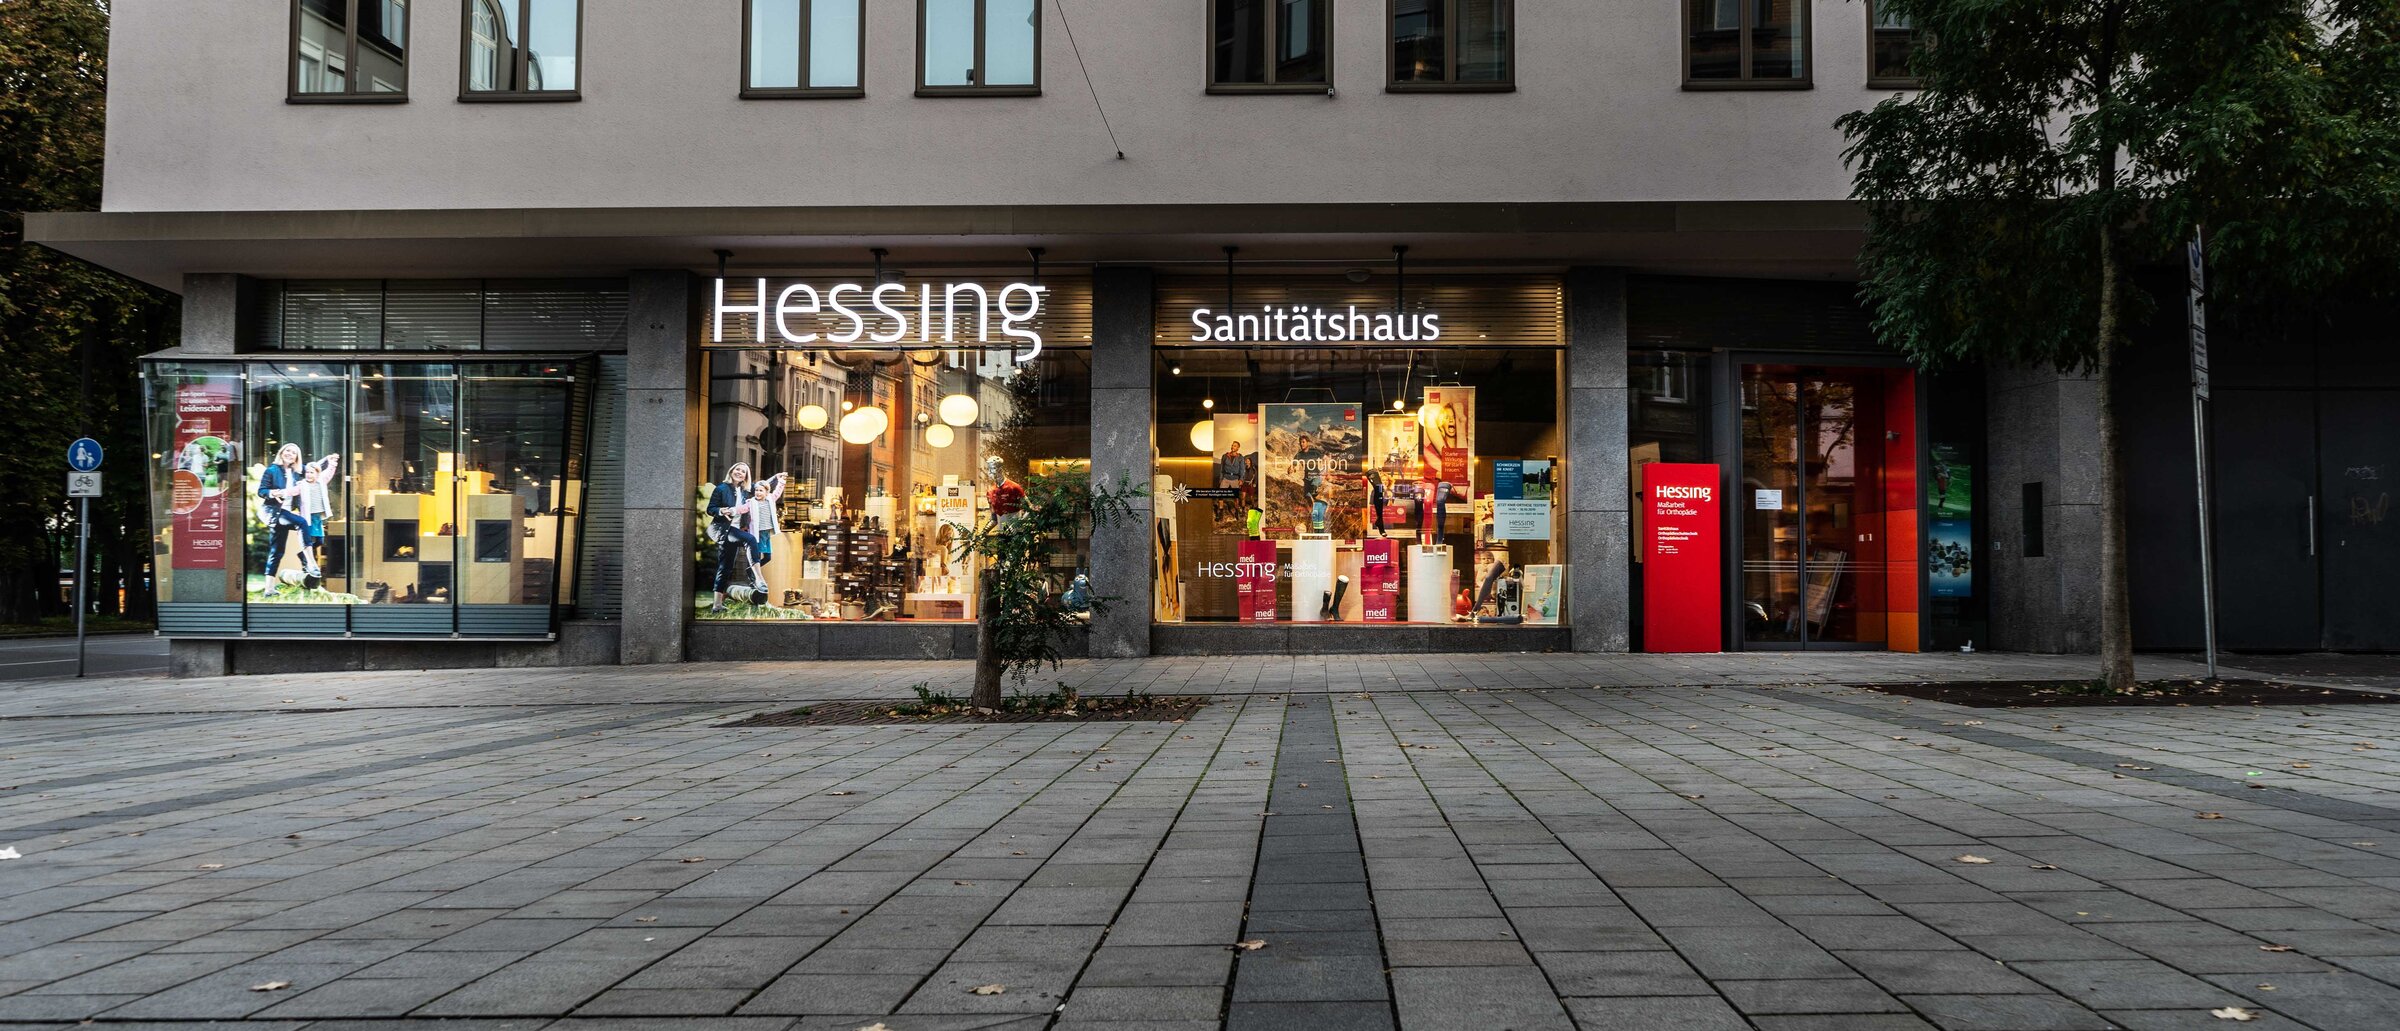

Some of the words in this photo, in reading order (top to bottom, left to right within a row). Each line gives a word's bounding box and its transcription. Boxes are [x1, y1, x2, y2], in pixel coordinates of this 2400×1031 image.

[713, 278, 1046, 362] Hessing
[1191, 305, 1440, 341] Sanitätshaus
[180, 404, 227, 412] Leidenschaft
[1656, 485, 1712, 502] Hessing
[941, 498, 968, 508] CLIMA
[1666, 508, 1698, 516] Orthopädie
[193, 539, 223, 548] Hessing
[1240, 554, 1255, 563] medi
[1367, 552, 1388, 561] medi
[1198, 561, 1277, 582] Hessing
[1239, 582, 1252, 590] medi
[1382, 581, 1398, 589] medi
[1256, 608, 1274, 617] medi
[1366, 608, 1387, 617] medi
